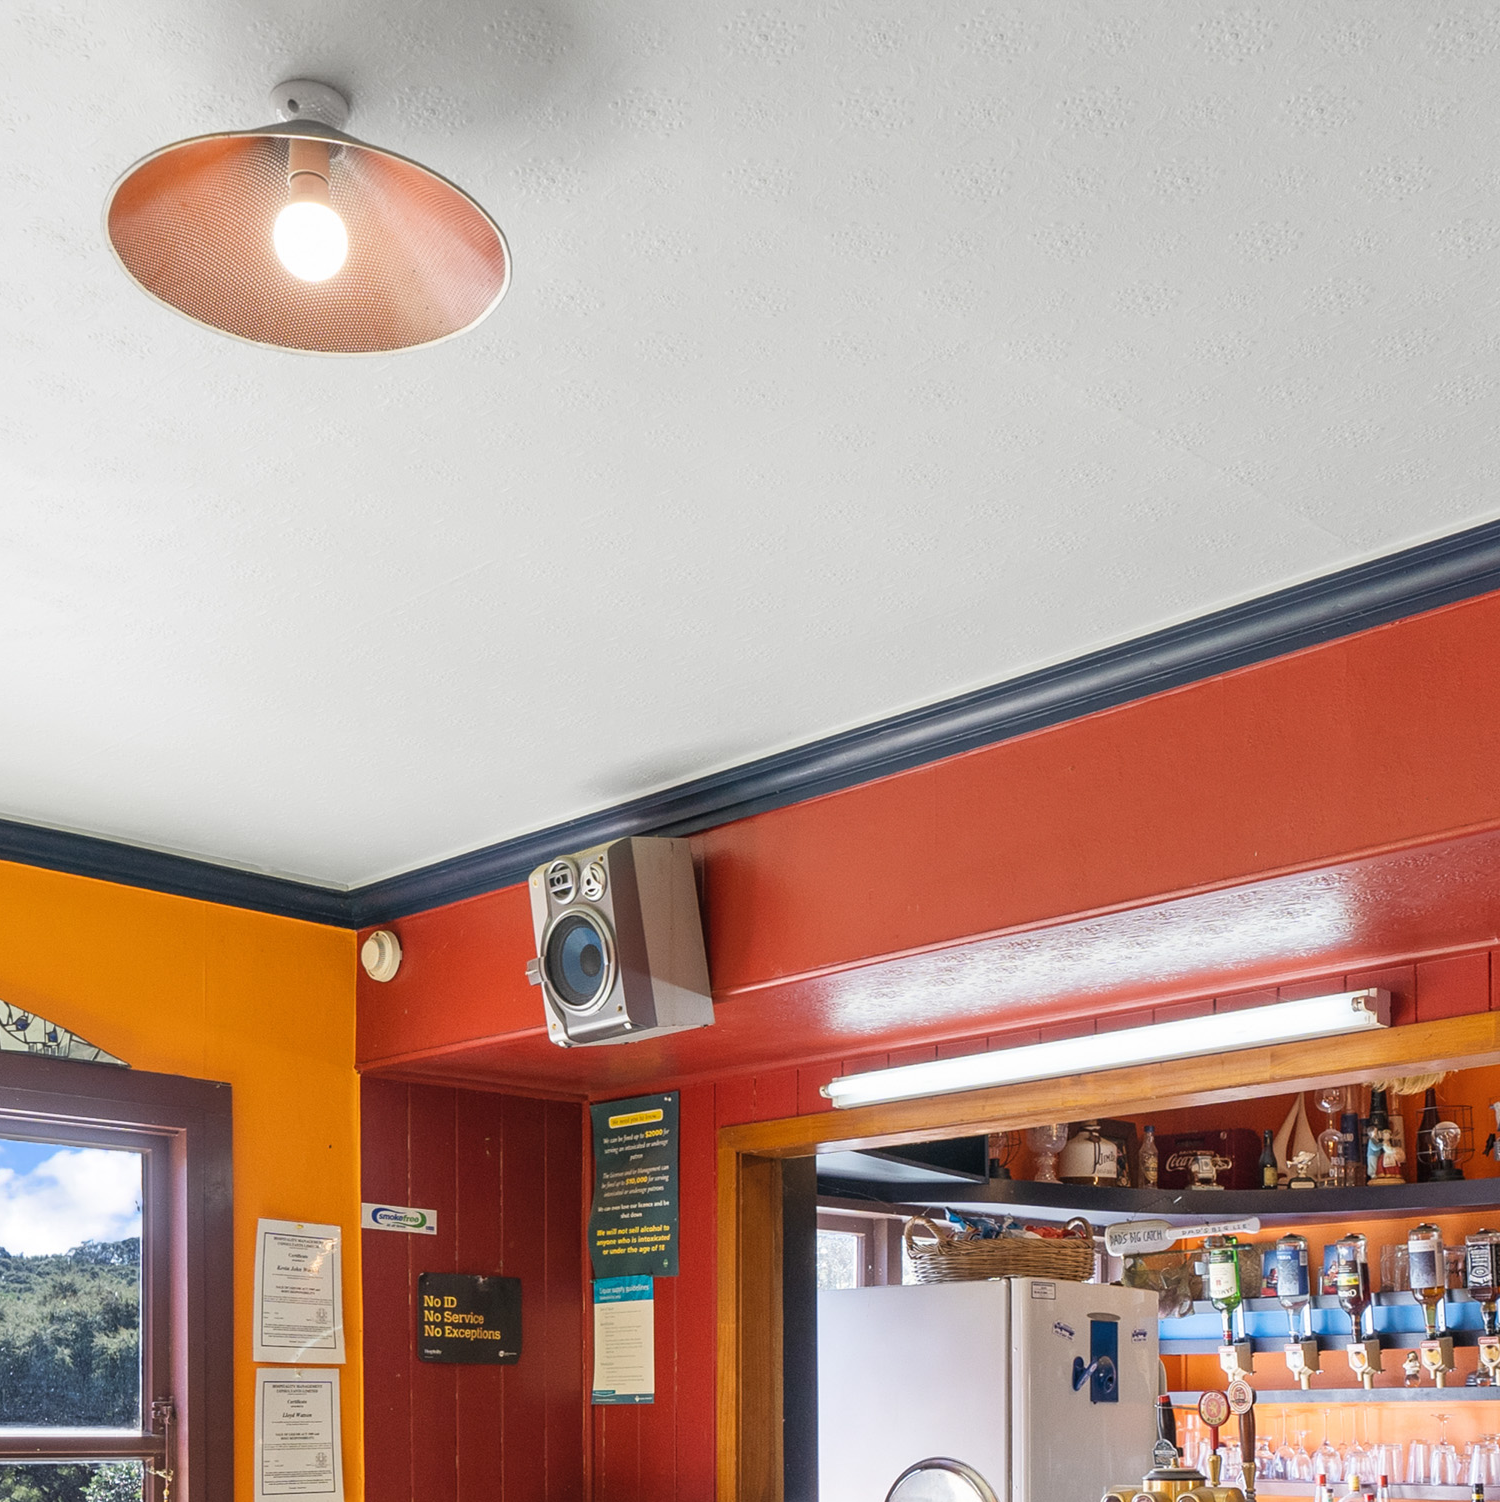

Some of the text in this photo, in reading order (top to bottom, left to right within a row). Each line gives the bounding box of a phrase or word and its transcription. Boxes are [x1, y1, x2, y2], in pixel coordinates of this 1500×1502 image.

[378, 1213, 419, 1223] smokefree
[1110, 1230, 1162, 1246] DAD'S BIG CATCH
[424, 1295, 457, 1308] No ID
[424, 1310, 484, 1325] No Service
[424, 1325, 501, 1341] No Exceptions
